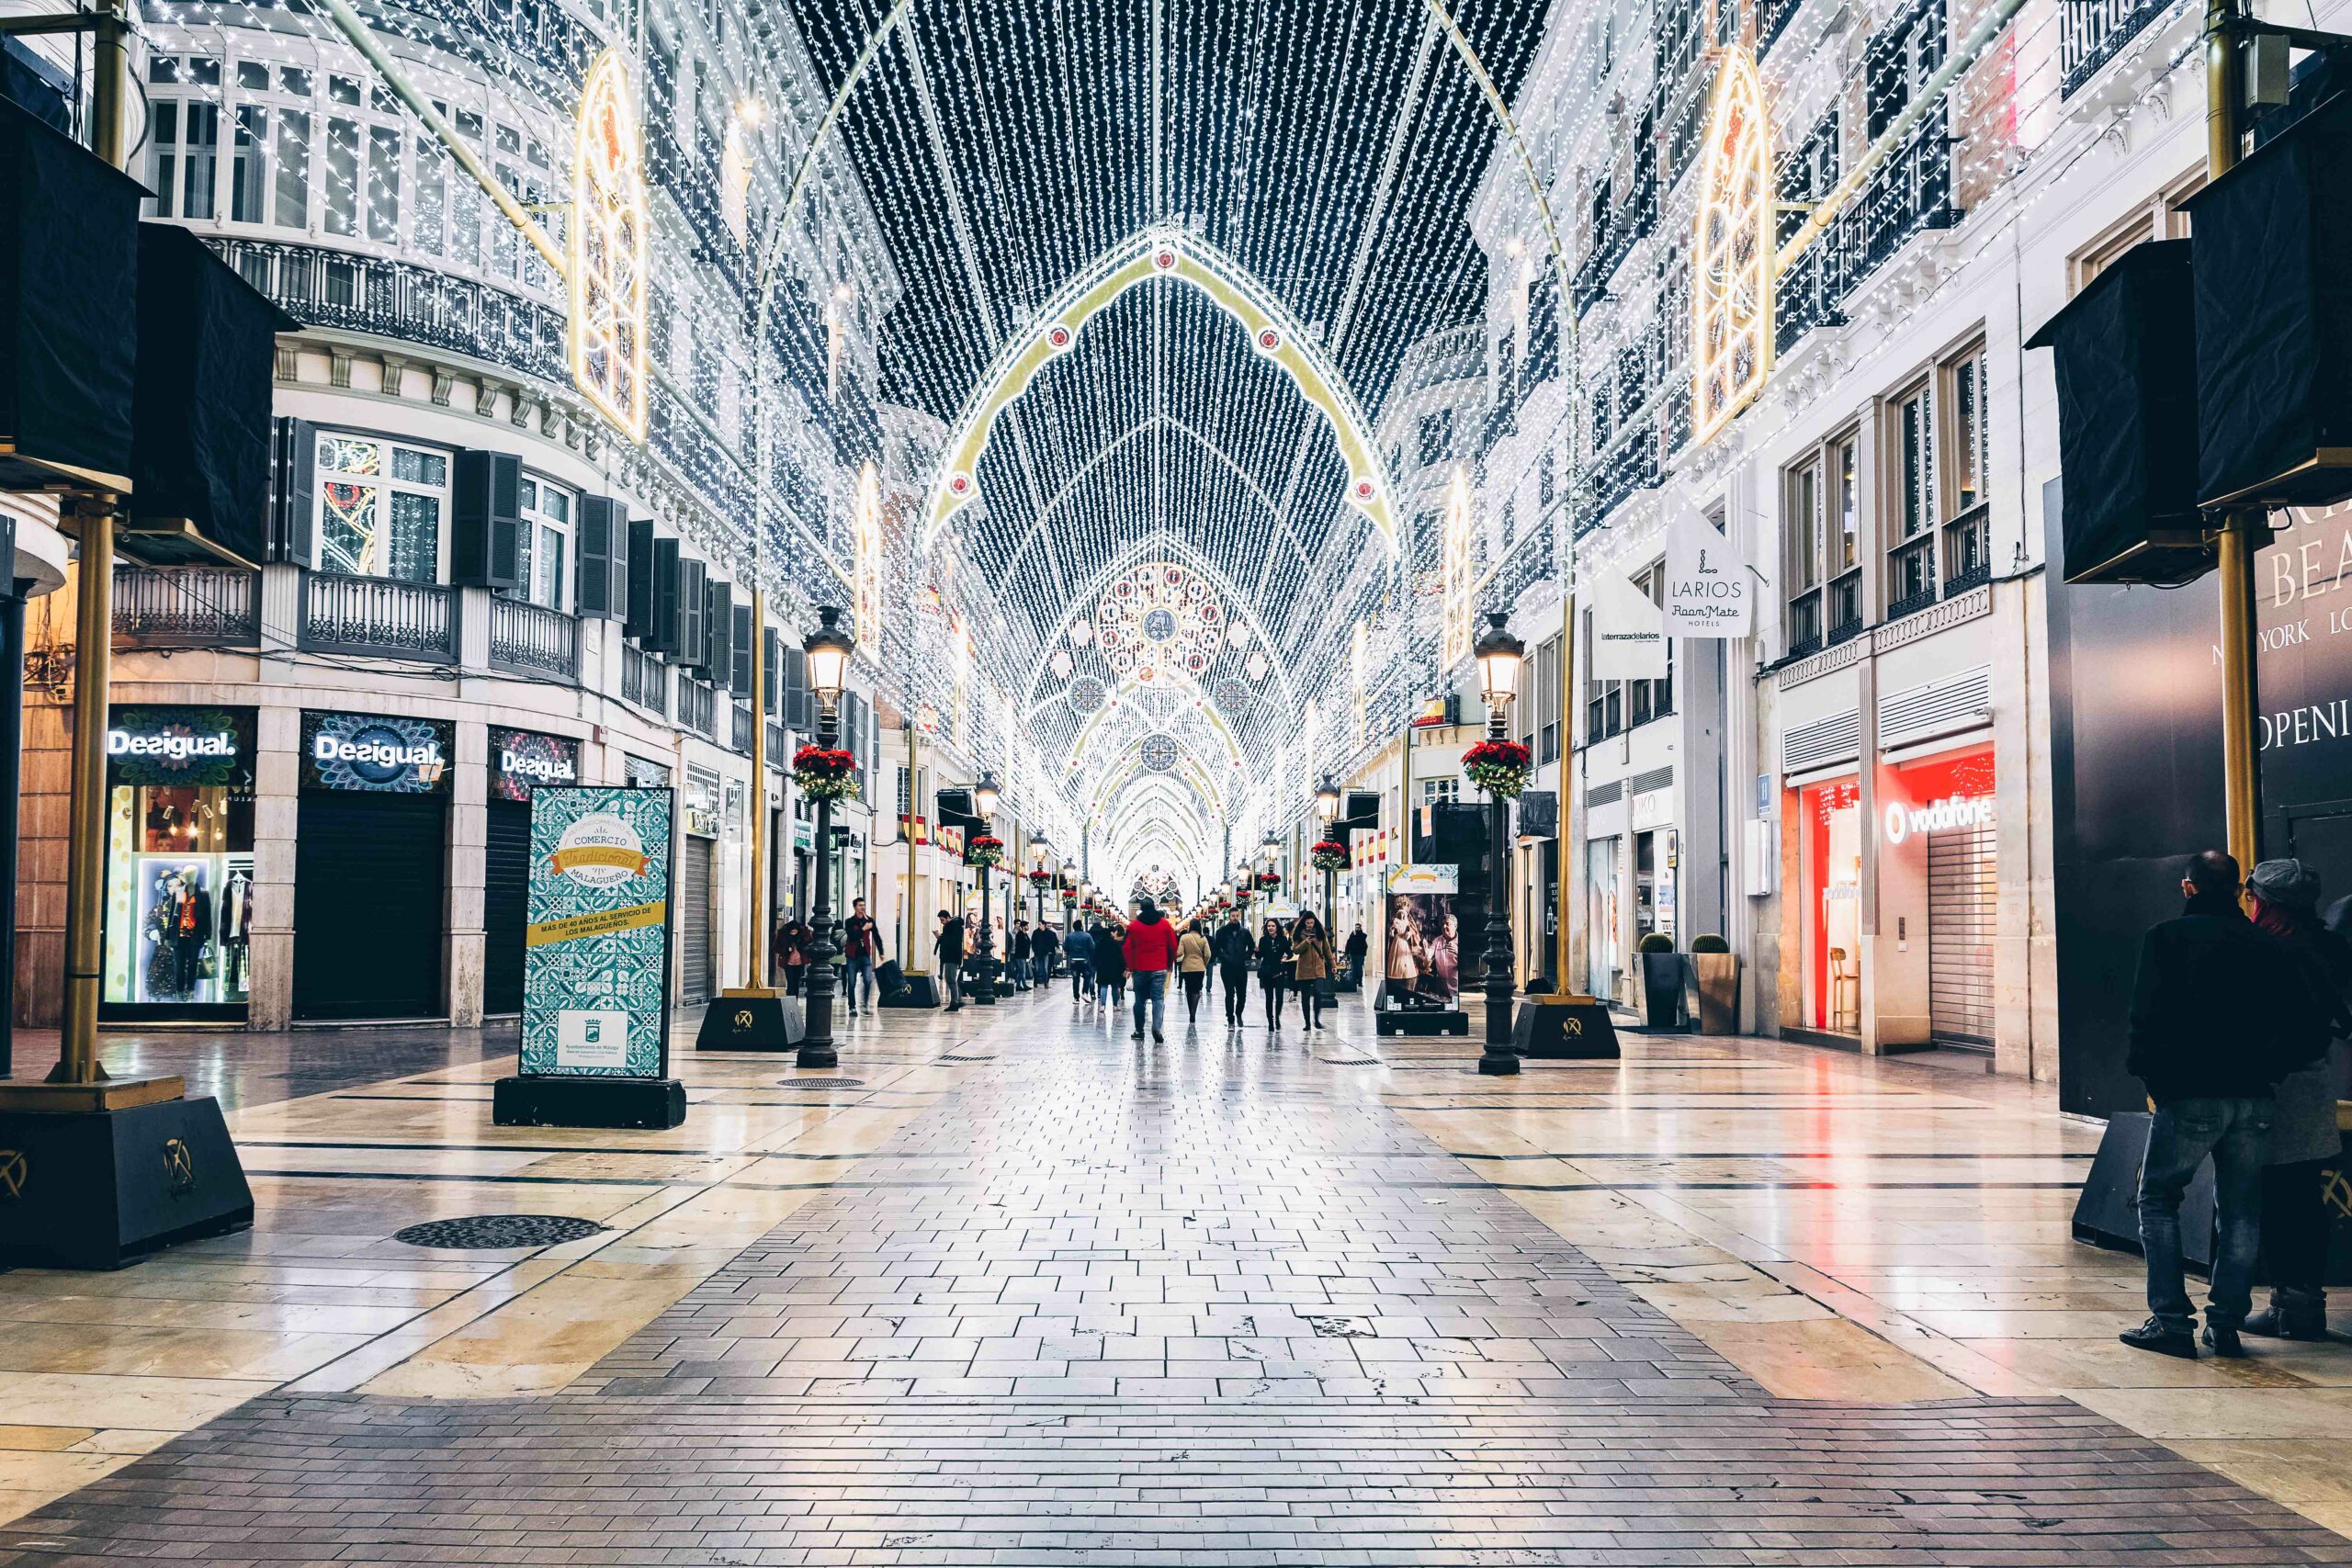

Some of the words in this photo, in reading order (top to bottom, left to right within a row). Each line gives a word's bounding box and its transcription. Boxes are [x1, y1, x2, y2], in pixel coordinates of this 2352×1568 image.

[1672, 581, 1742, 598] LARIOS
[1705, 604, 1740, 619] Mate
[2258, 618, 2312, 652] YORK
[1632, 794, 1656, 818] KIKO
[1908, 795, 1992, 832] vodafone
[574, 835, 628, 846] COMERCIO
[562, 850, 637, 866] Tradicional
[571, 868, 628, 884] MALAGUEÑO
[579, 917, 599, 926] AÑOS
[609, 909, 641, 920] SERVICIO
[565, 928, 579, 936] LOS
